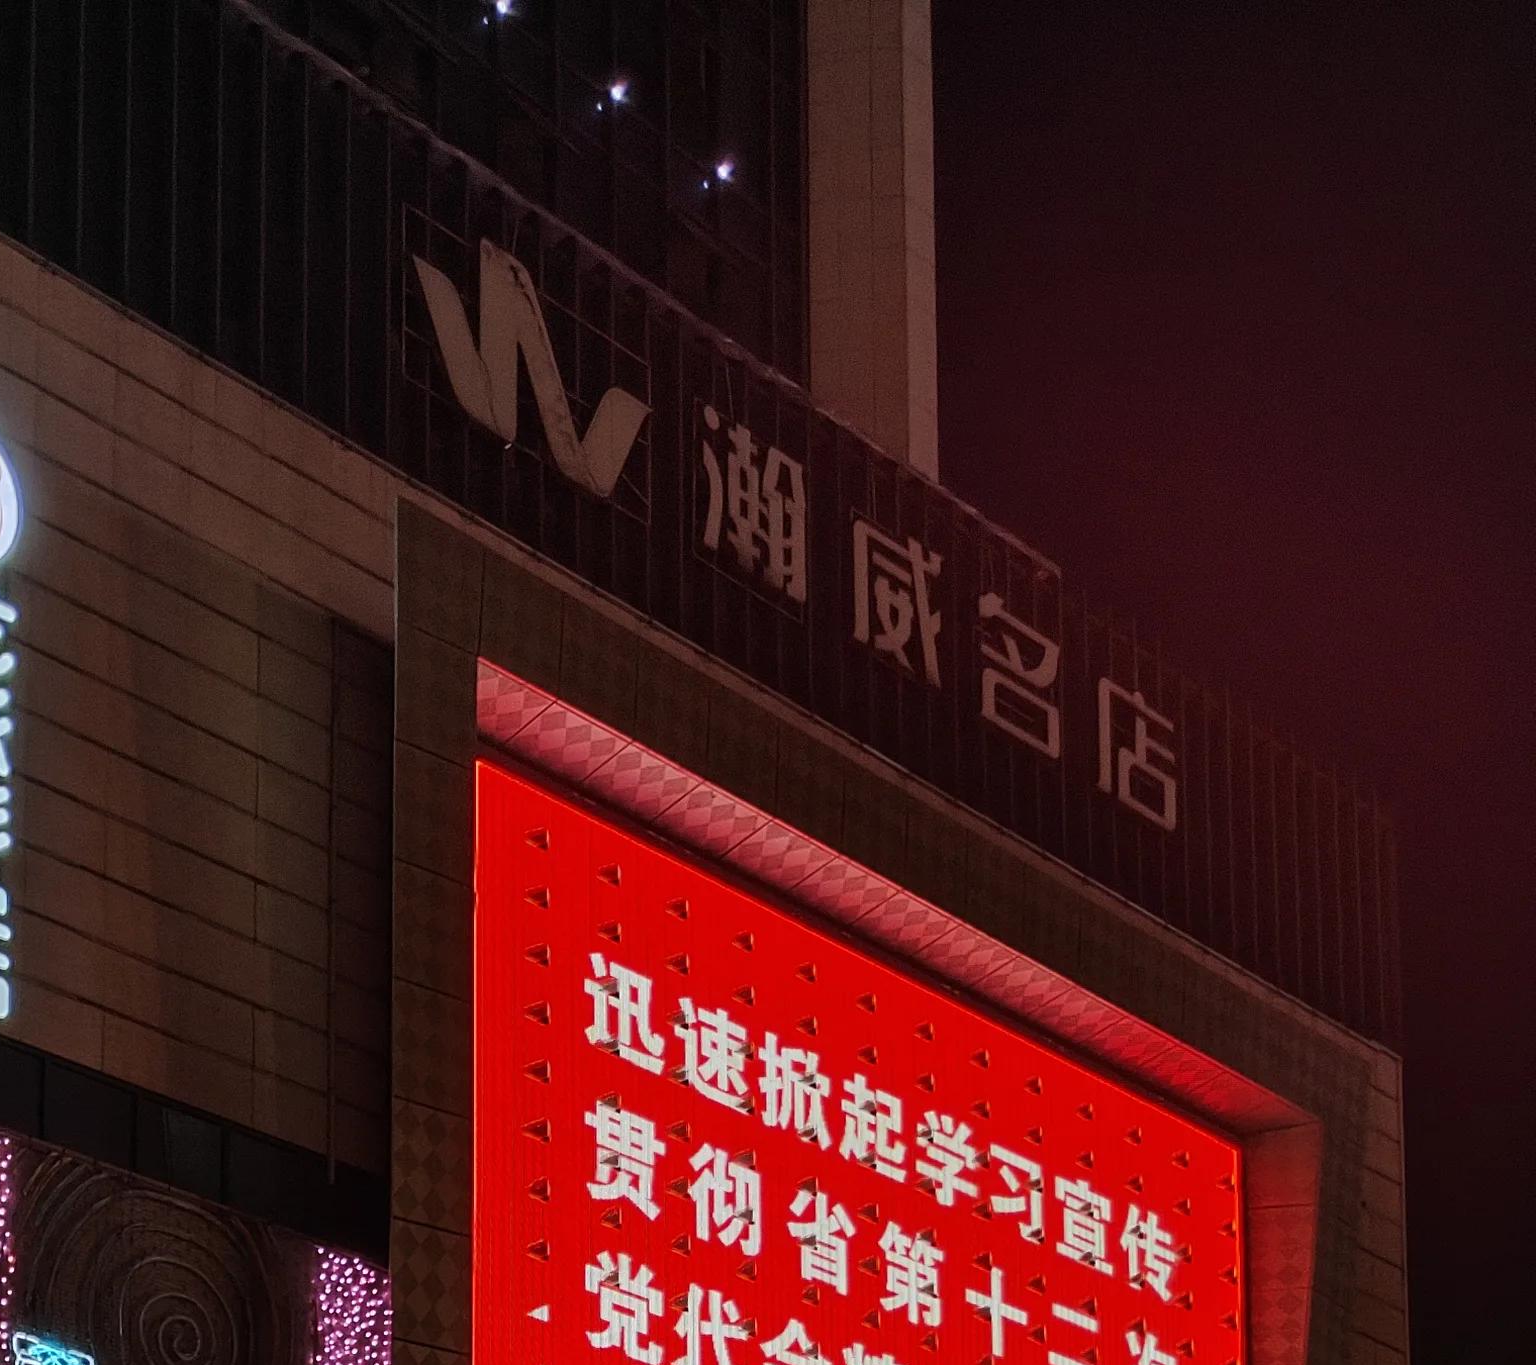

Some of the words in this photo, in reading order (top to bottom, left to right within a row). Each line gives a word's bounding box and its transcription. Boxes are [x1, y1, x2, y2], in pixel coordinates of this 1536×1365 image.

[700, 404, 1177, 832] 瀚威名店
[584, 952, 1180, 1302] 迅速掀起学习宣传
